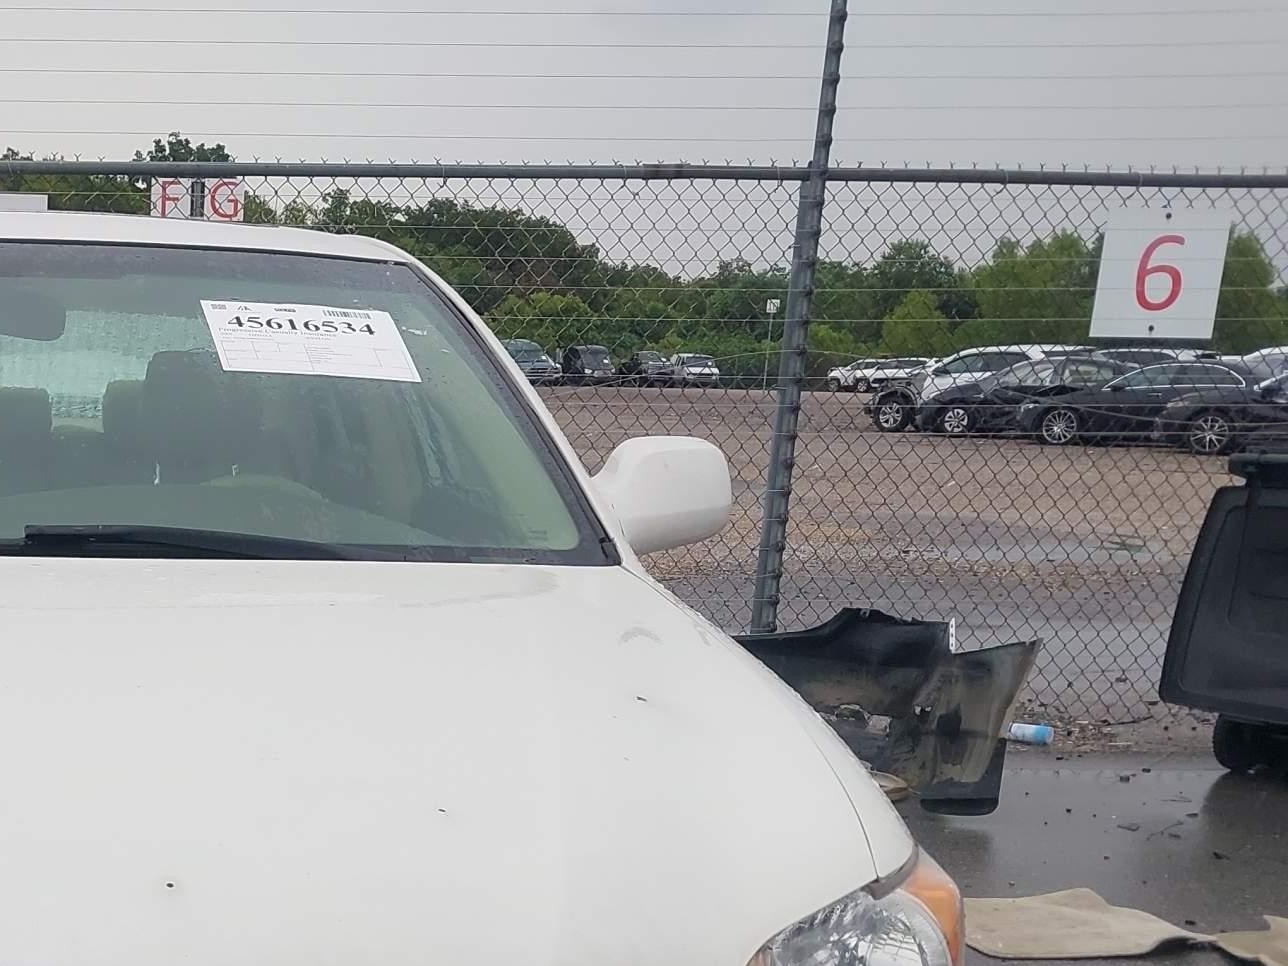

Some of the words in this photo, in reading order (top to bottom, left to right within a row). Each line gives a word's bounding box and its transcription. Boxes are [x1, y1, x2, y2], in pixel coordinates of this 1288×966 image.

[161, 181, 180, 217] F
[210, 182, 239, 219] G
[1135, 234, 1185, 311] 6
[227, 315, 376, 336] 45616534
